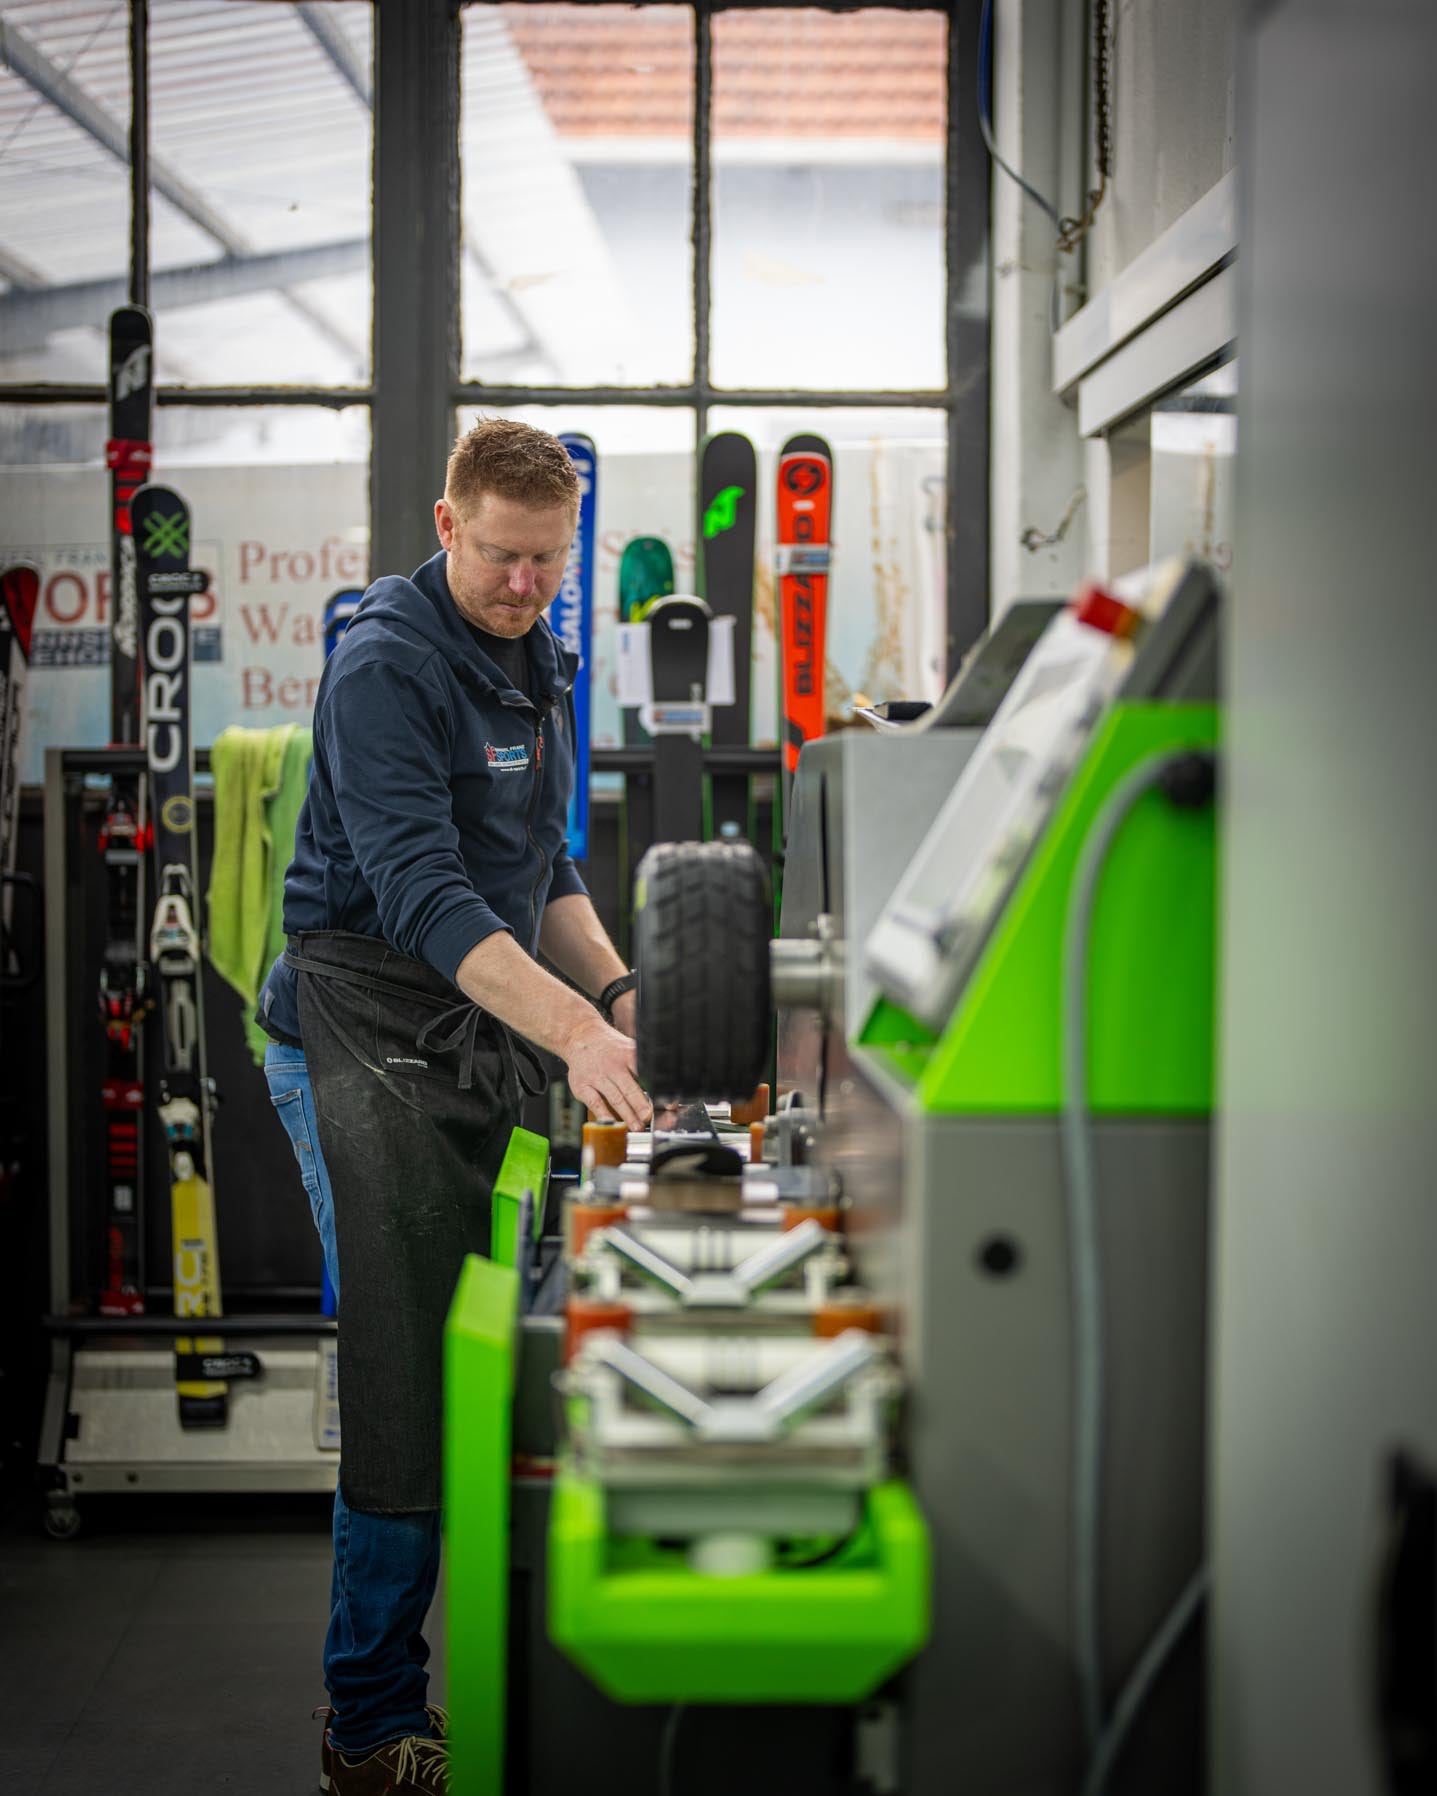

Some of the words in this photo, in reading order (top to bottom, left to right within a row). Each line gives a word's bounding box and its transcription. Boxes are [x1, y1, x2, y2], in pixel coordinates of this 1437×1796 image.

[239, 535, 369, 585] Profe
[239, 603, 323, 646] Wa
[794, 515, 814, 695] BLIZZAD
[496, 748, 527, 762] SPORTS
